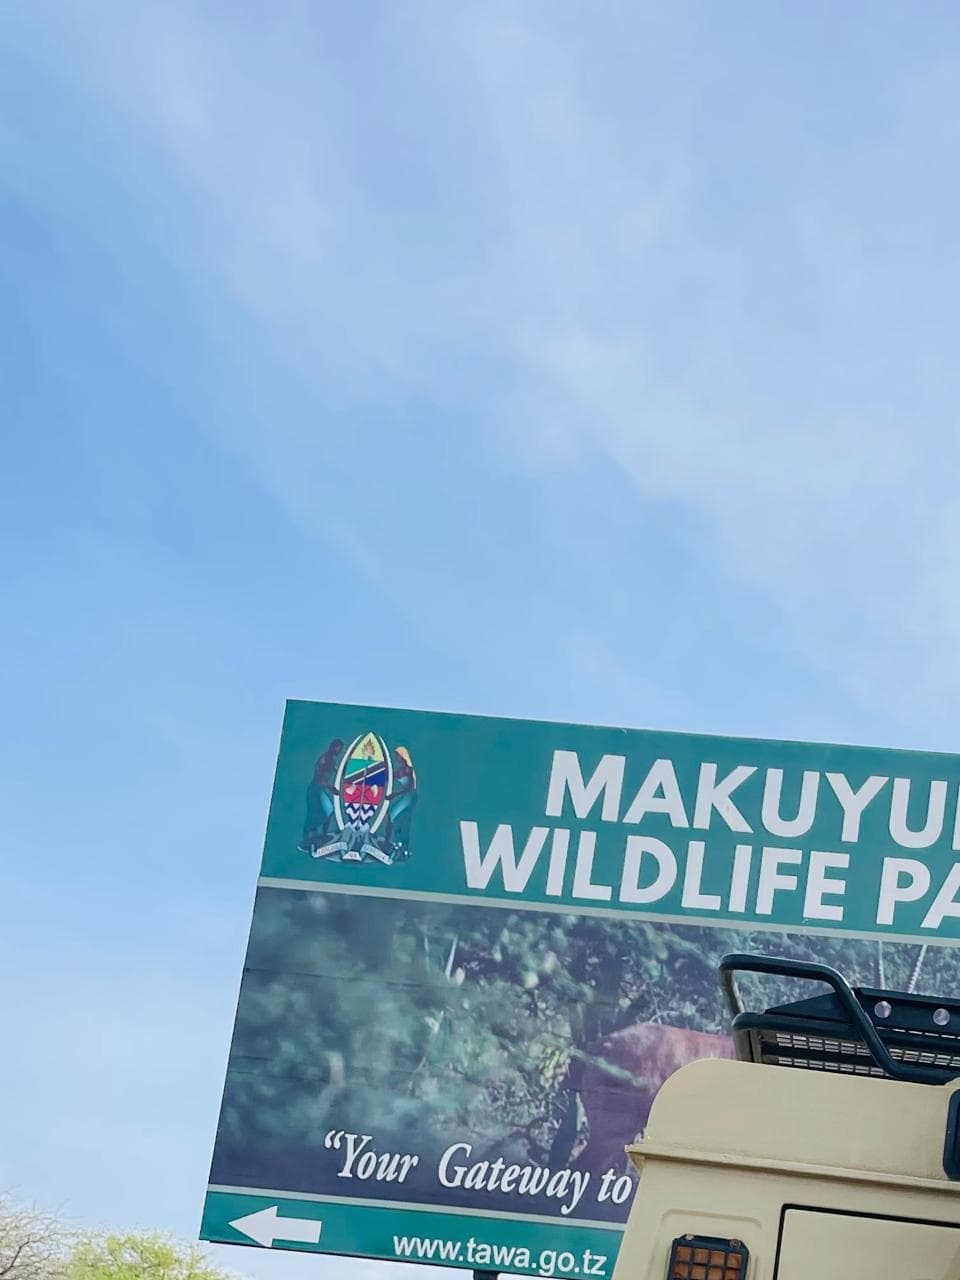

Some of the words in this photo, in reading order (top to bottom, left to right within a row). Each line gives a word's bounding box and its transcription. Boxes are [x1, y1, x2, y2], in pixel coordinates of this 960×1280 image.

[460, 820, 850, 921] WILDLIFE
[438, 1142, 590, 1215] Gateway
[597, 1168, 632, 1204] to
[393, 1235, 607, 1276] www.tawa.go.tz
